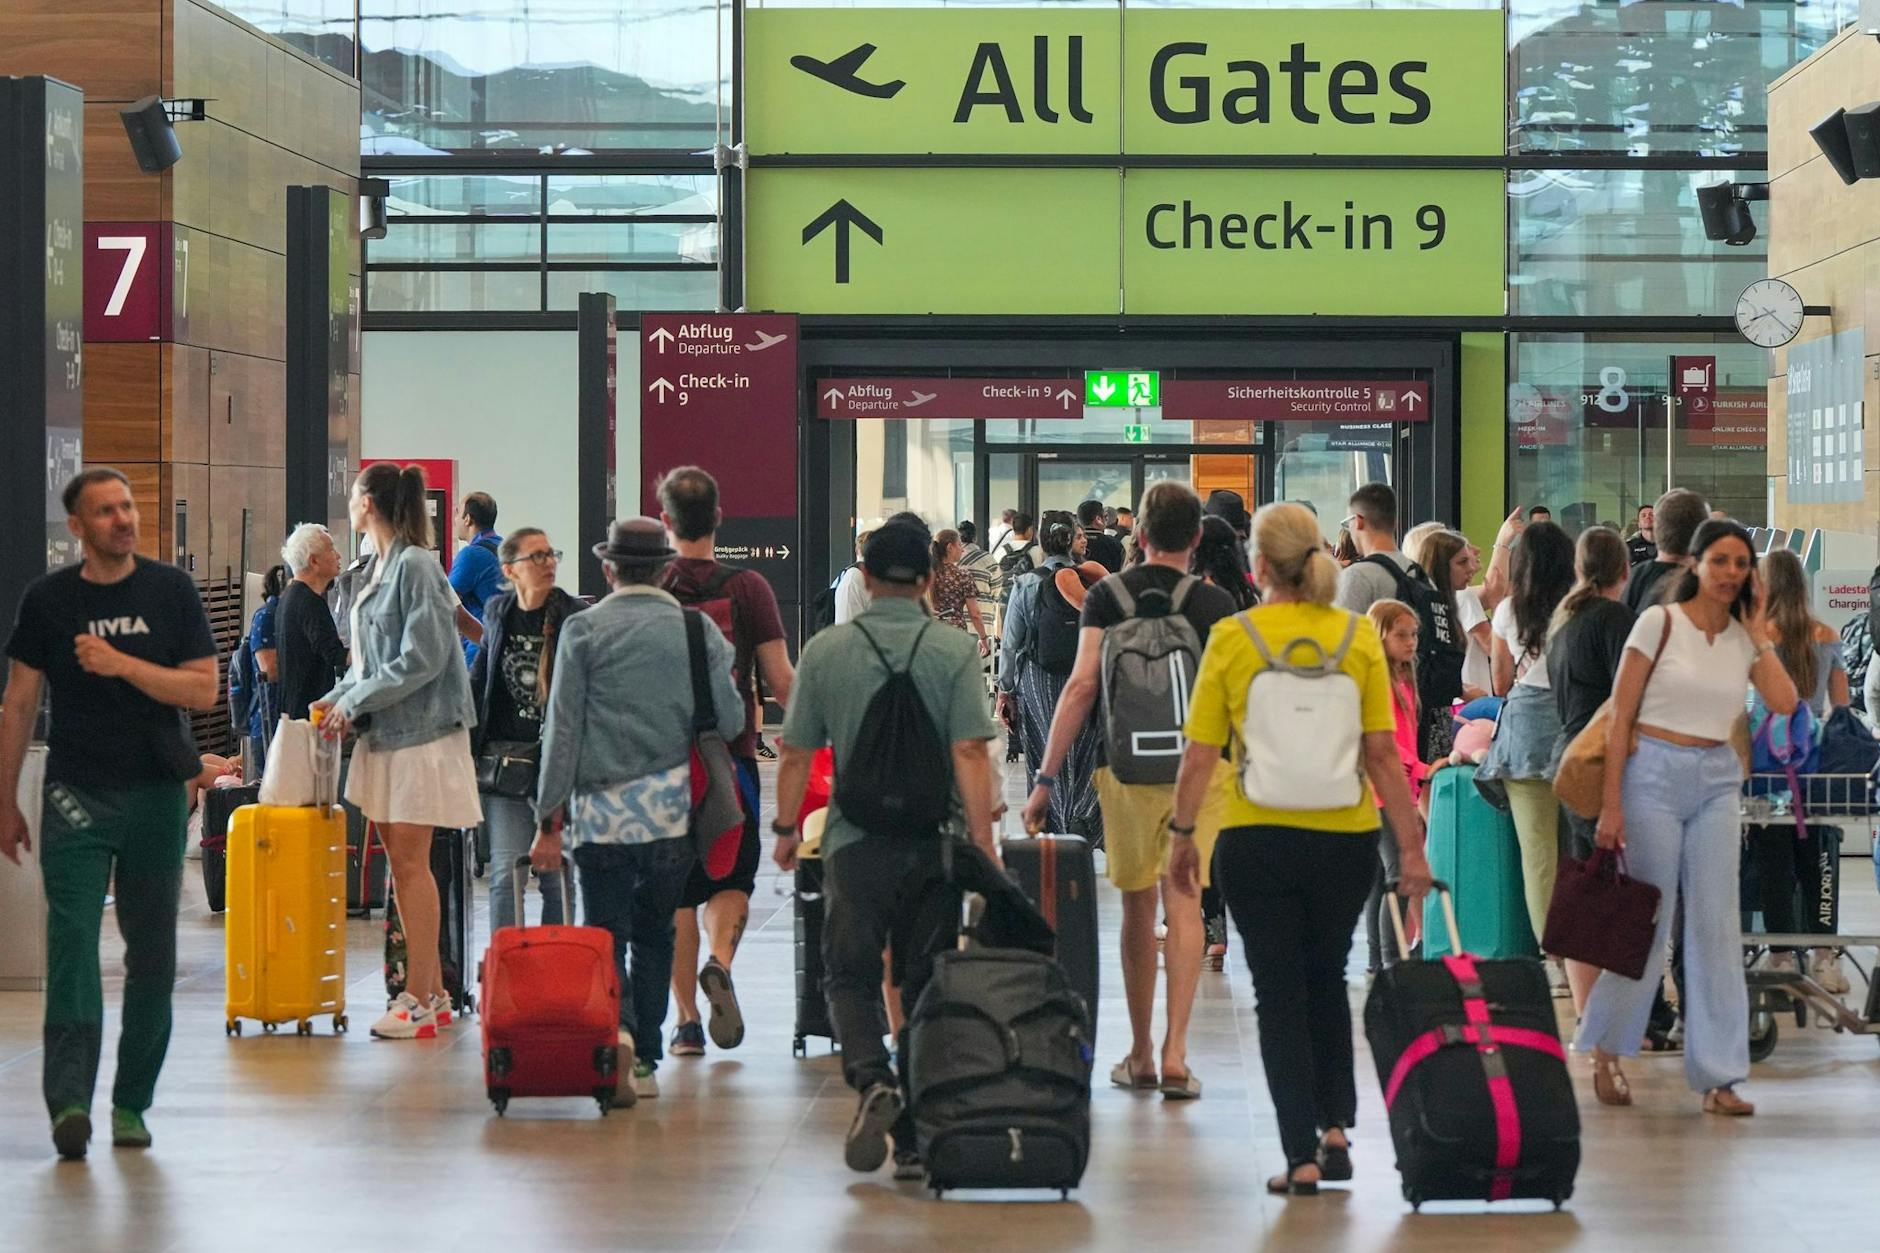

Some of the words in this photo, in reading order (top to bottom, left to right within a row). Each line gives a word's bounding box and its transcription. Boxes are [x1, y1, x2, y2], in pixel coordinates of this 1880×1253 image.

[953, 36, 1094, 124] All
[1150, 41, 1431, 125] Gates
[1146, 200, 1393, 250] Check-in
[1415, 204, 1446, 250] 9
[98, 236, 147, 316] 7
[678, 324, 733, 342] Abflug
[679, 342, 741, 357] Departure
[679, 373, 750, 389] Check-in
[848, 385, 893, 400] Abflug
[982, 385, 1040, 398] Check-in
[1044, 386, 1052, 398] 9
[1227, 386, 1360, 399] Sicherheitskontrolle
[1363, 387, 1371, 399] 5
[1599, 366, 1629, 413] 8
[679, 392, 689, 406] 9
[849, 400, 899, 411] Departure
[1712, 401, 1748, 409] TURKISH
[1291, 401, 1332, 413] Security
[1334, 402, 1371, 411] Control
[1819, 902, 1832, 926] AIR
